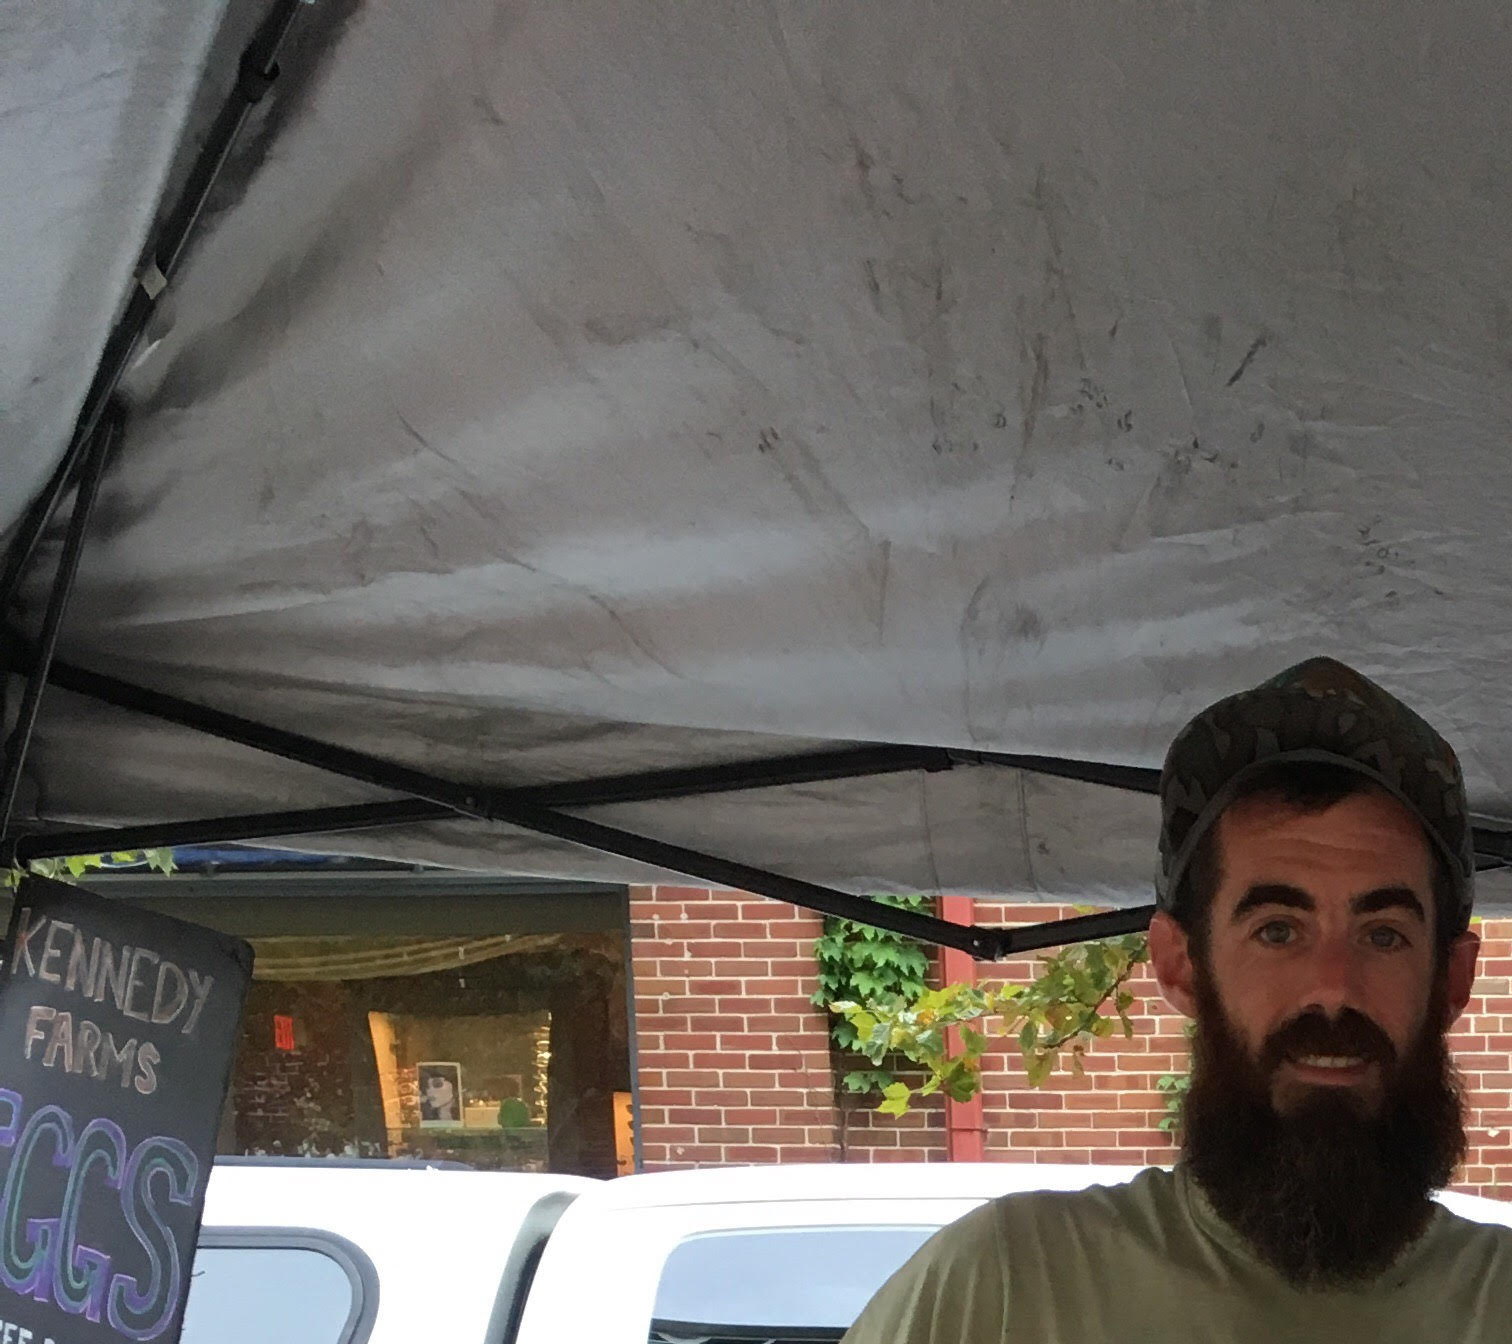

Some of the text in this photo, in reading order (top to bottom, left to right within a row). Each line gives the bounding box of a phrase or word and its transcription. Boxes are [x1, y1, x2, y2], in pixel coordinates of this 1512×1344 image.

[12, 907, 214, 1034] KENNEDY
[25, 1004, 162, 1095] FARMS
[0, 1087, 199, 1341] GGS
